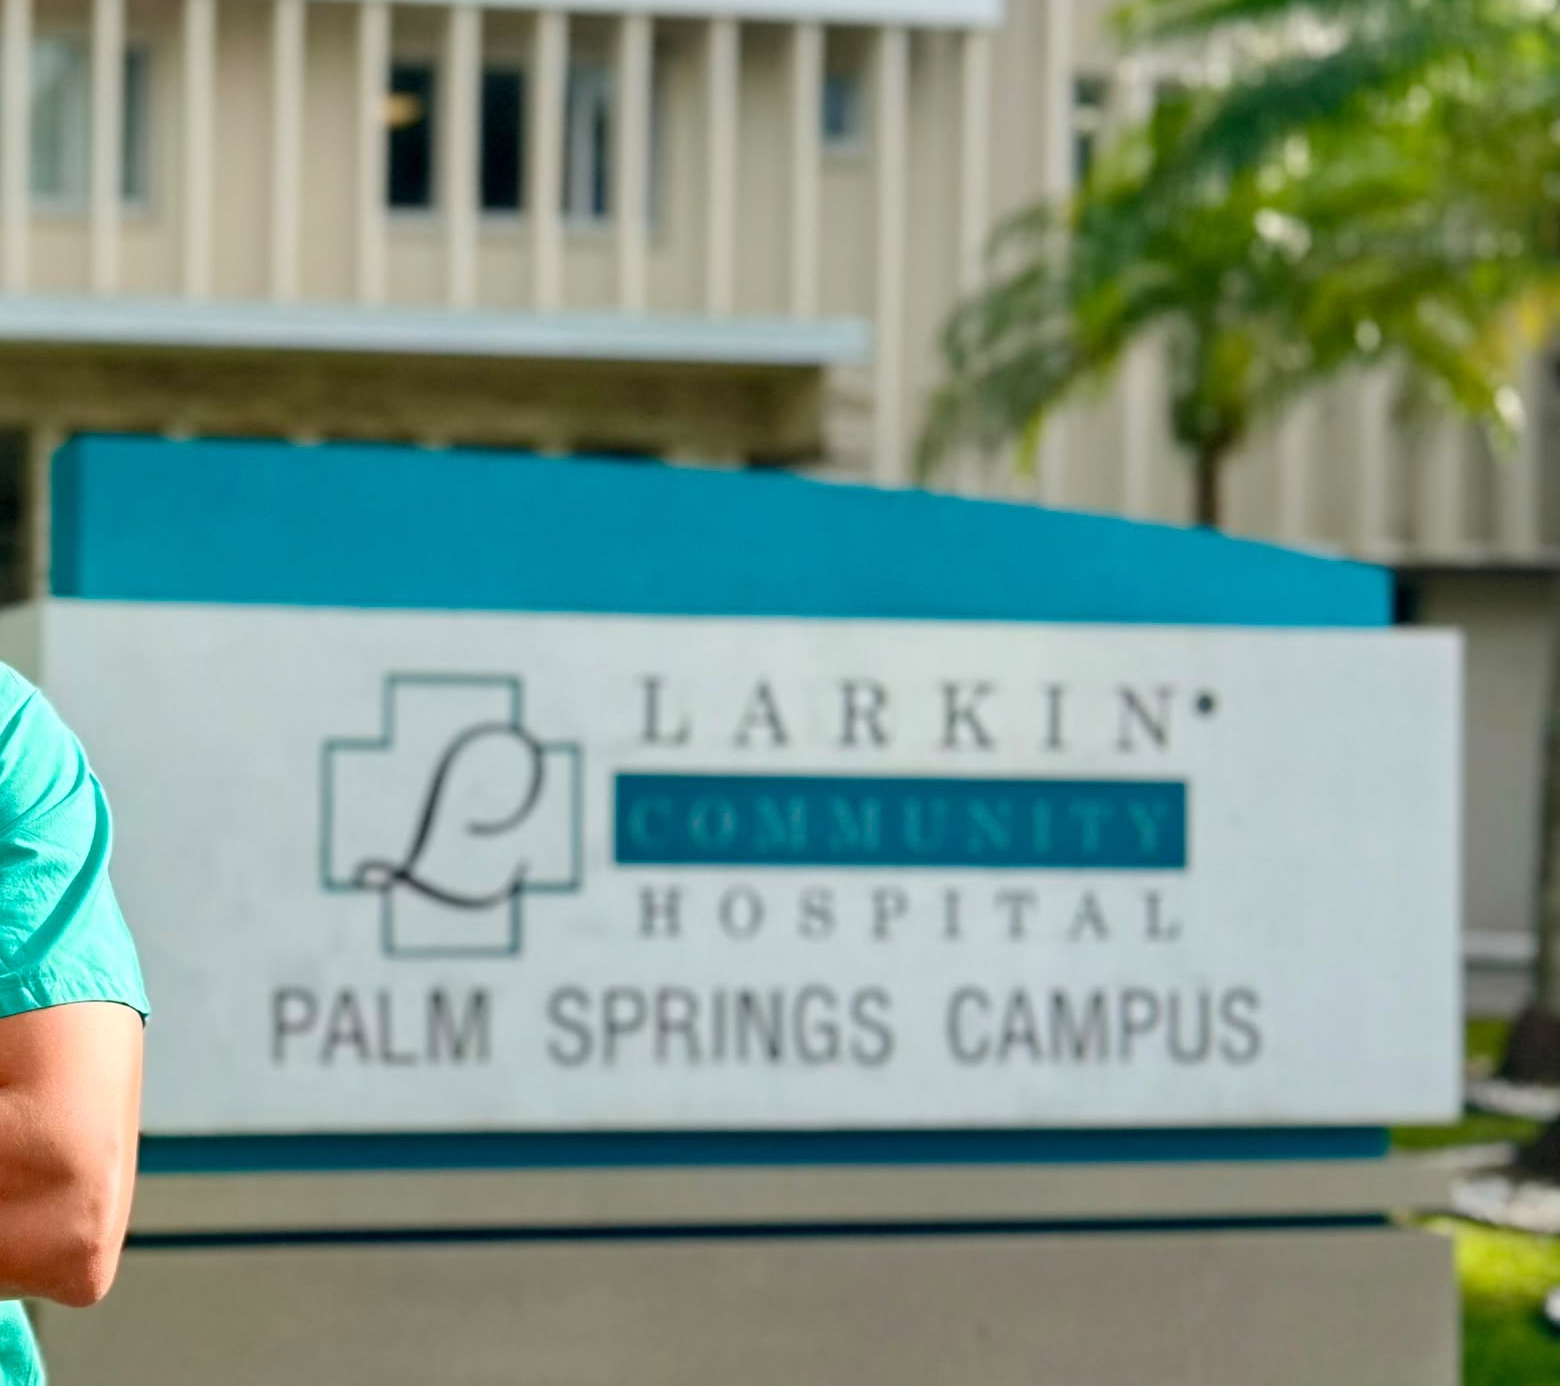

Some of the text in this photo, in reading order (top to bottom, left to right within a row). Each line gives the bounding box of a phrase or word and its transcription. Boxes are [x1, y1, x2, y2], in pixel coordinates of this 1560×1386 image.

[638, 676, 1175, 752] LARKIN
[626, 791, 1170, 855] COMMUNITY
[638, 883, 1181, 941] HOSPITAL
[270, 984, 1264, 1069] PALM SPRINGS CAMPUS
